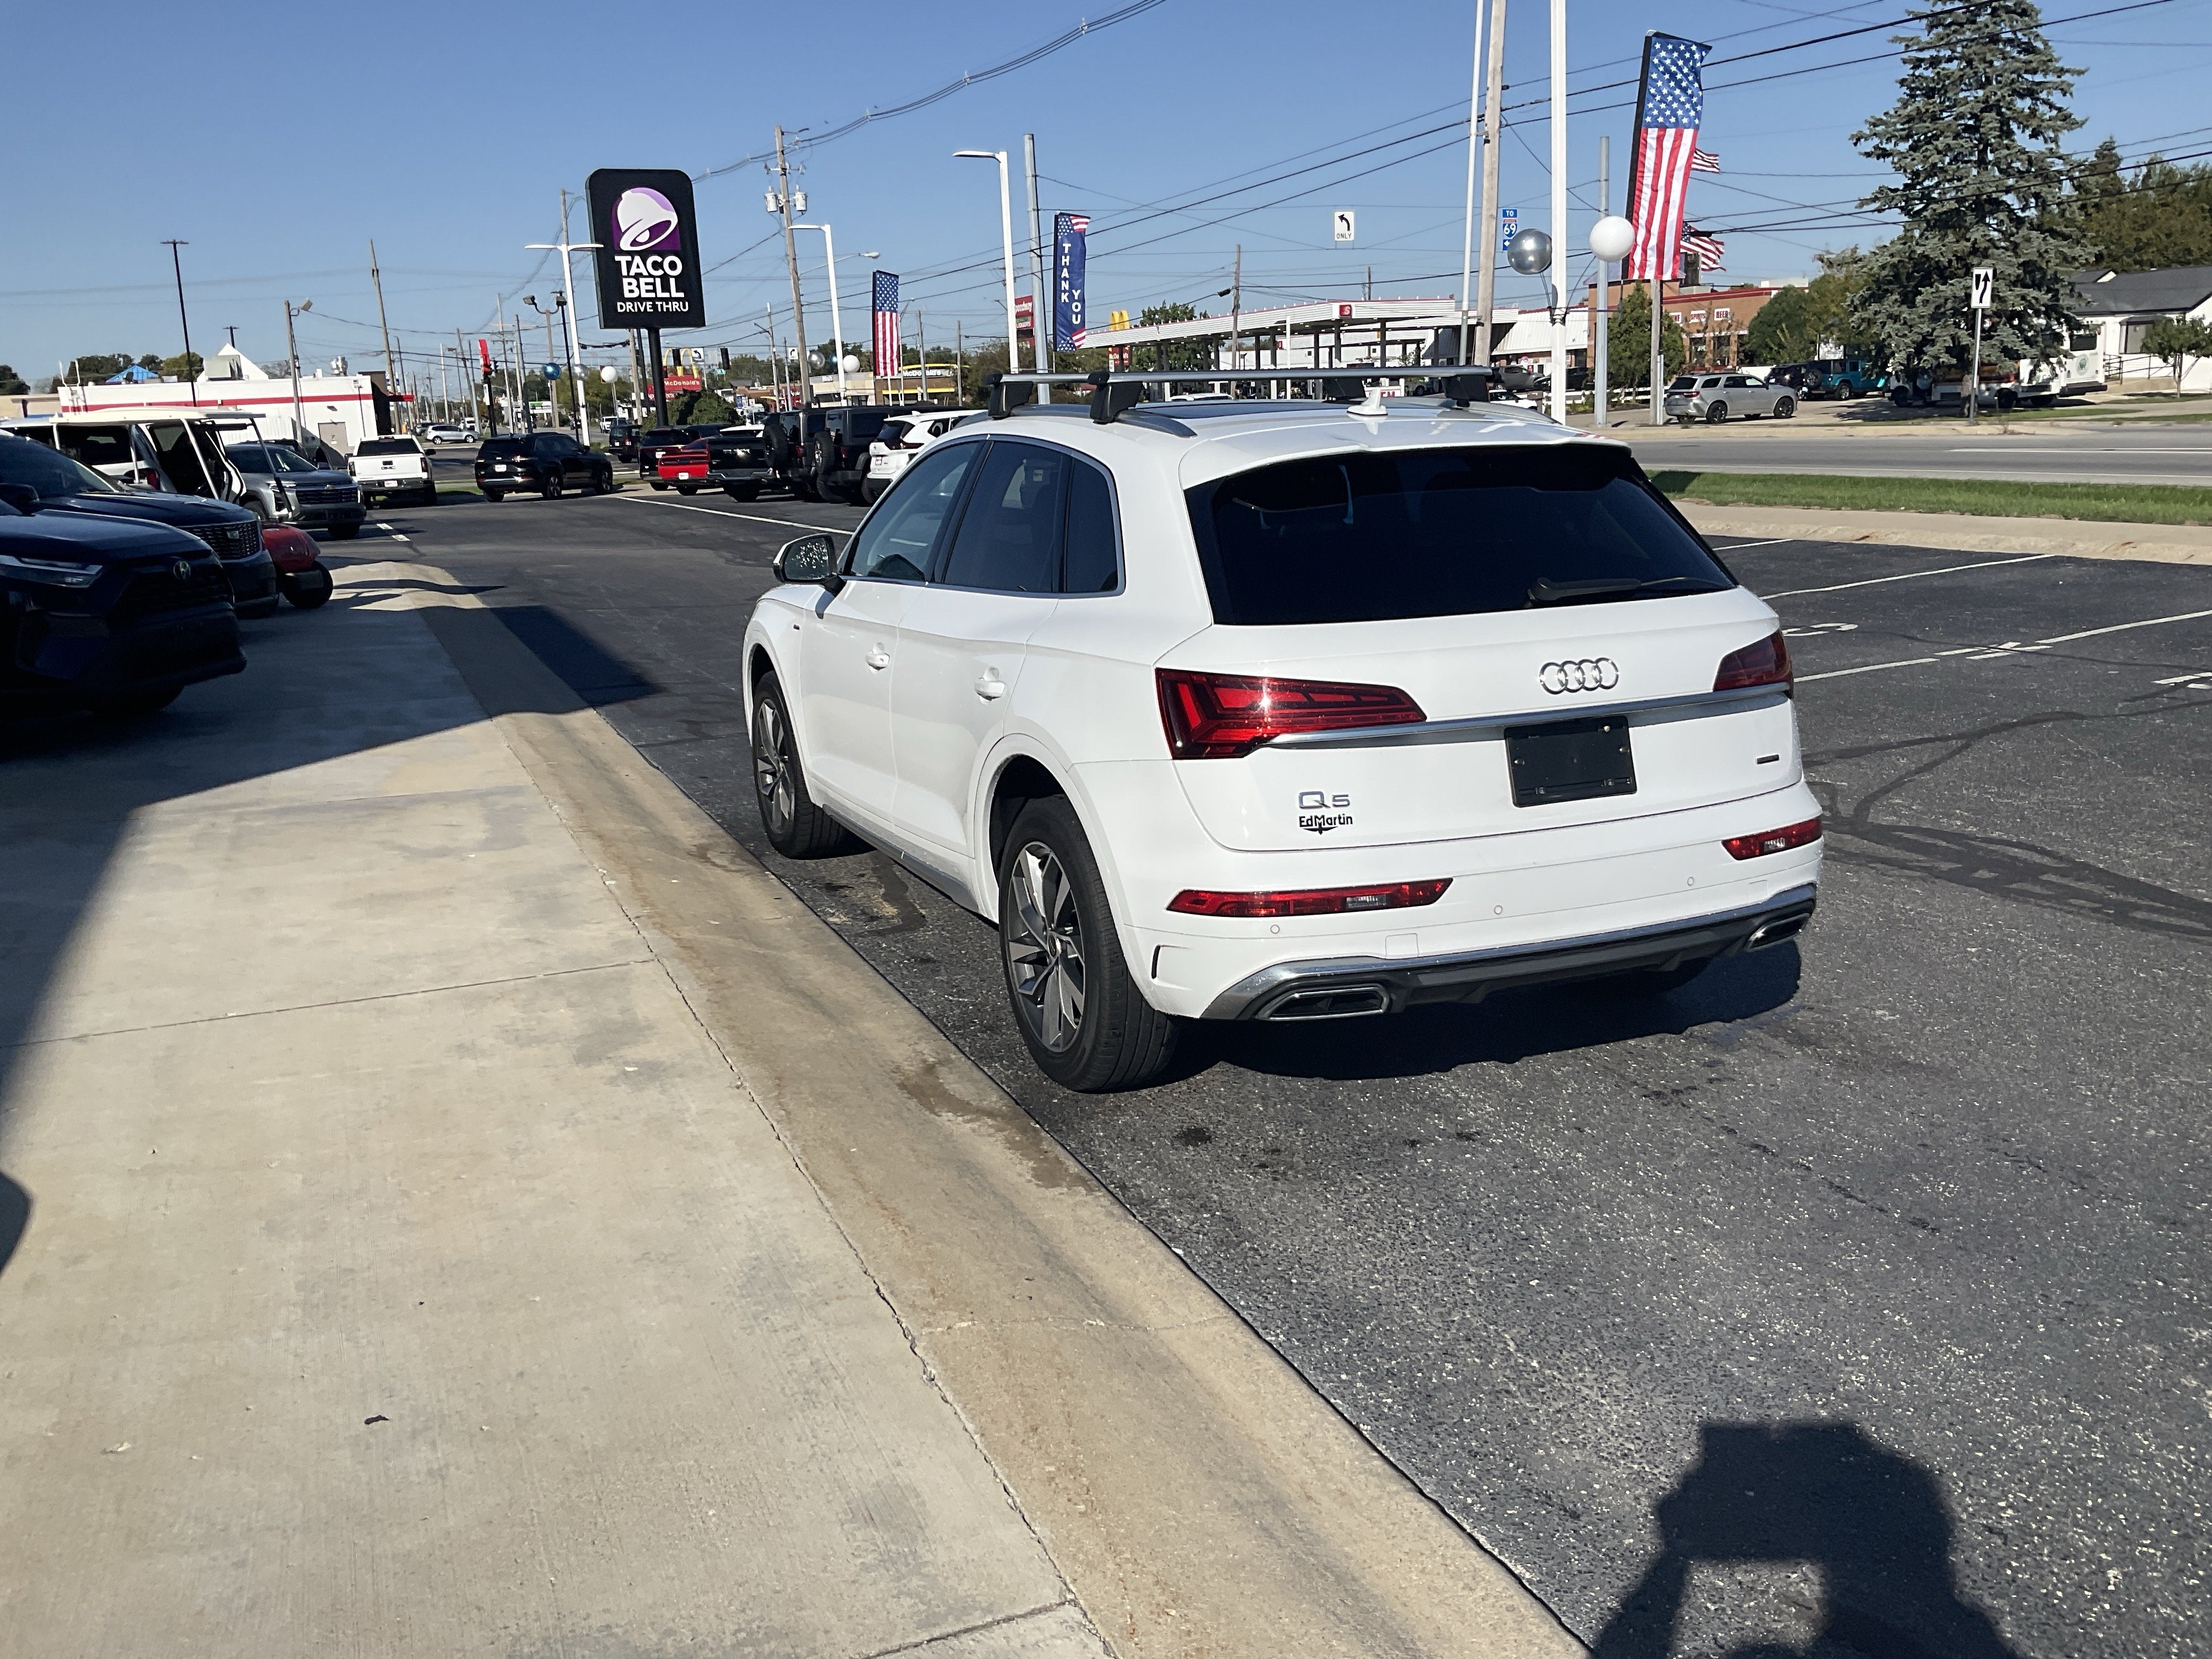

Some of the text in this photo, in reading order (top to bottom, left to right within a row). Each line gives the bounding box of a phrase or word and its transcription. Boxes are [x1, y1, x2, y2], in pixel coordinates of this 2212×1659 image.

[1504, 223, 1516, 234] 69
[614, 256, 682, 276] TACO
[1061, 243, 1071, 303] THANK
[622, 278, 685, 298] BELL
[617, 301, 689, 313] DRIVE THRU
[1071, 289, 1081, 324] YOU
[1716, 311, 1729, 319] BEER
